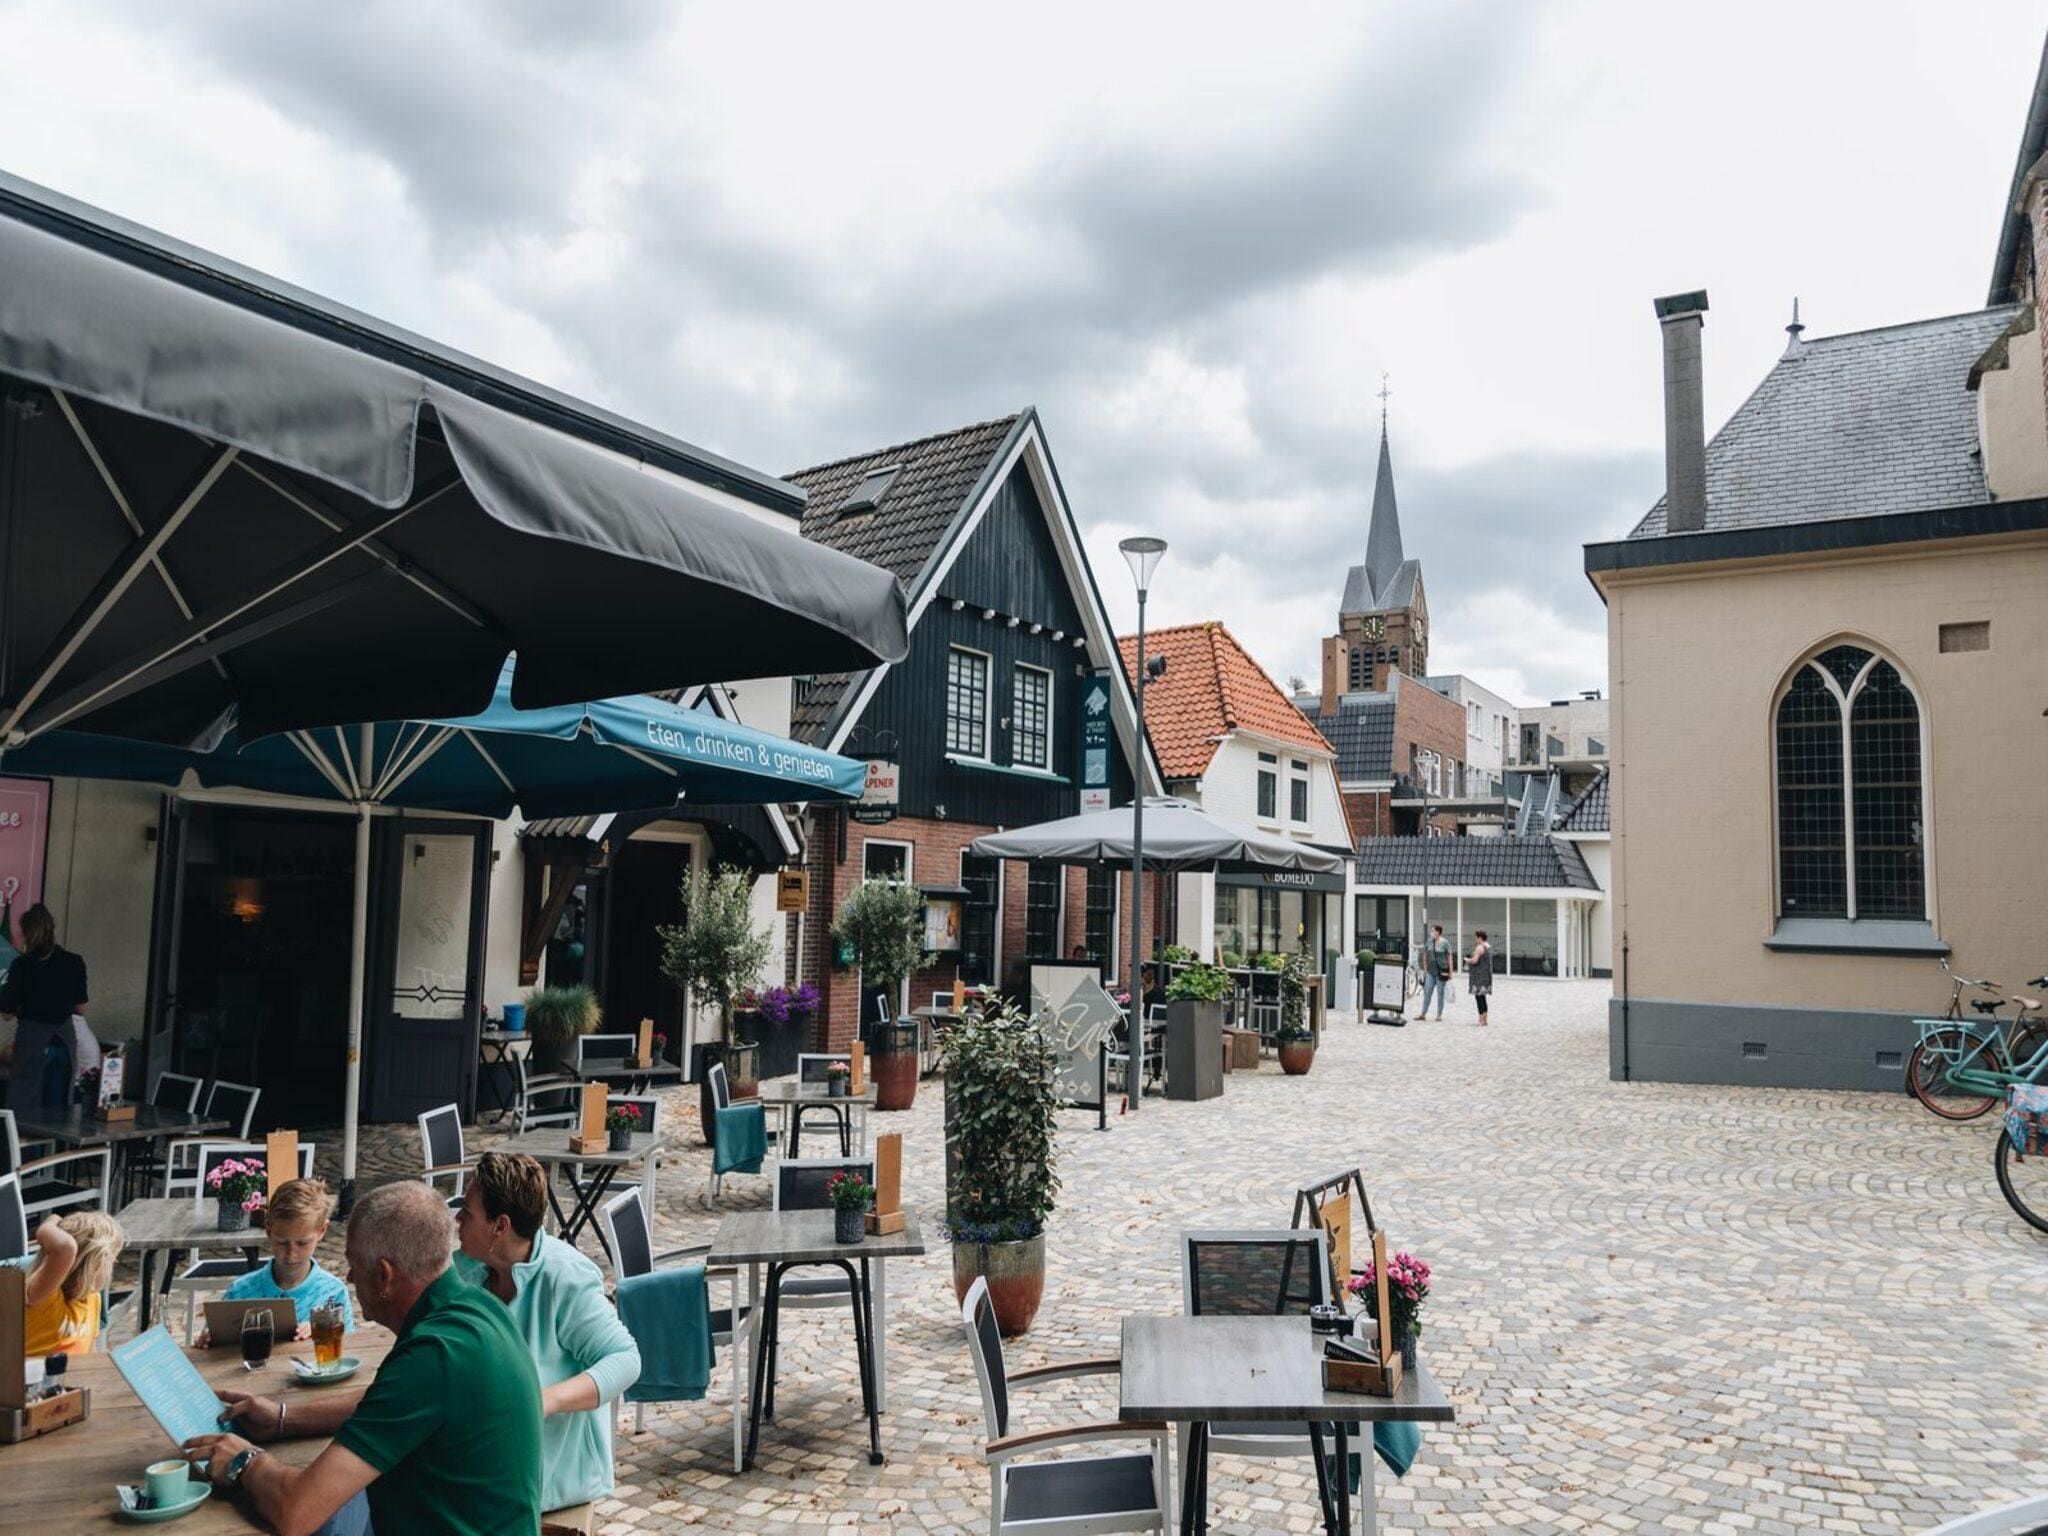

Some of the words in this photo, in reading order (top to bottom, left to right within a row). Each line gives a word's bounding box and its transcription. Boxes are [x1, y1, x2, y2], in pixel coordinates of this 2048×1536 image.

[647, 720, 691, 754] Eten,
[695, 730, 754, 763] drinken
[757, 744, 771, 767] &
[773, 752, 834, 780] genieten
[865, 778, 894, 788] LPENER
[0, 811, 21, 827] ee
